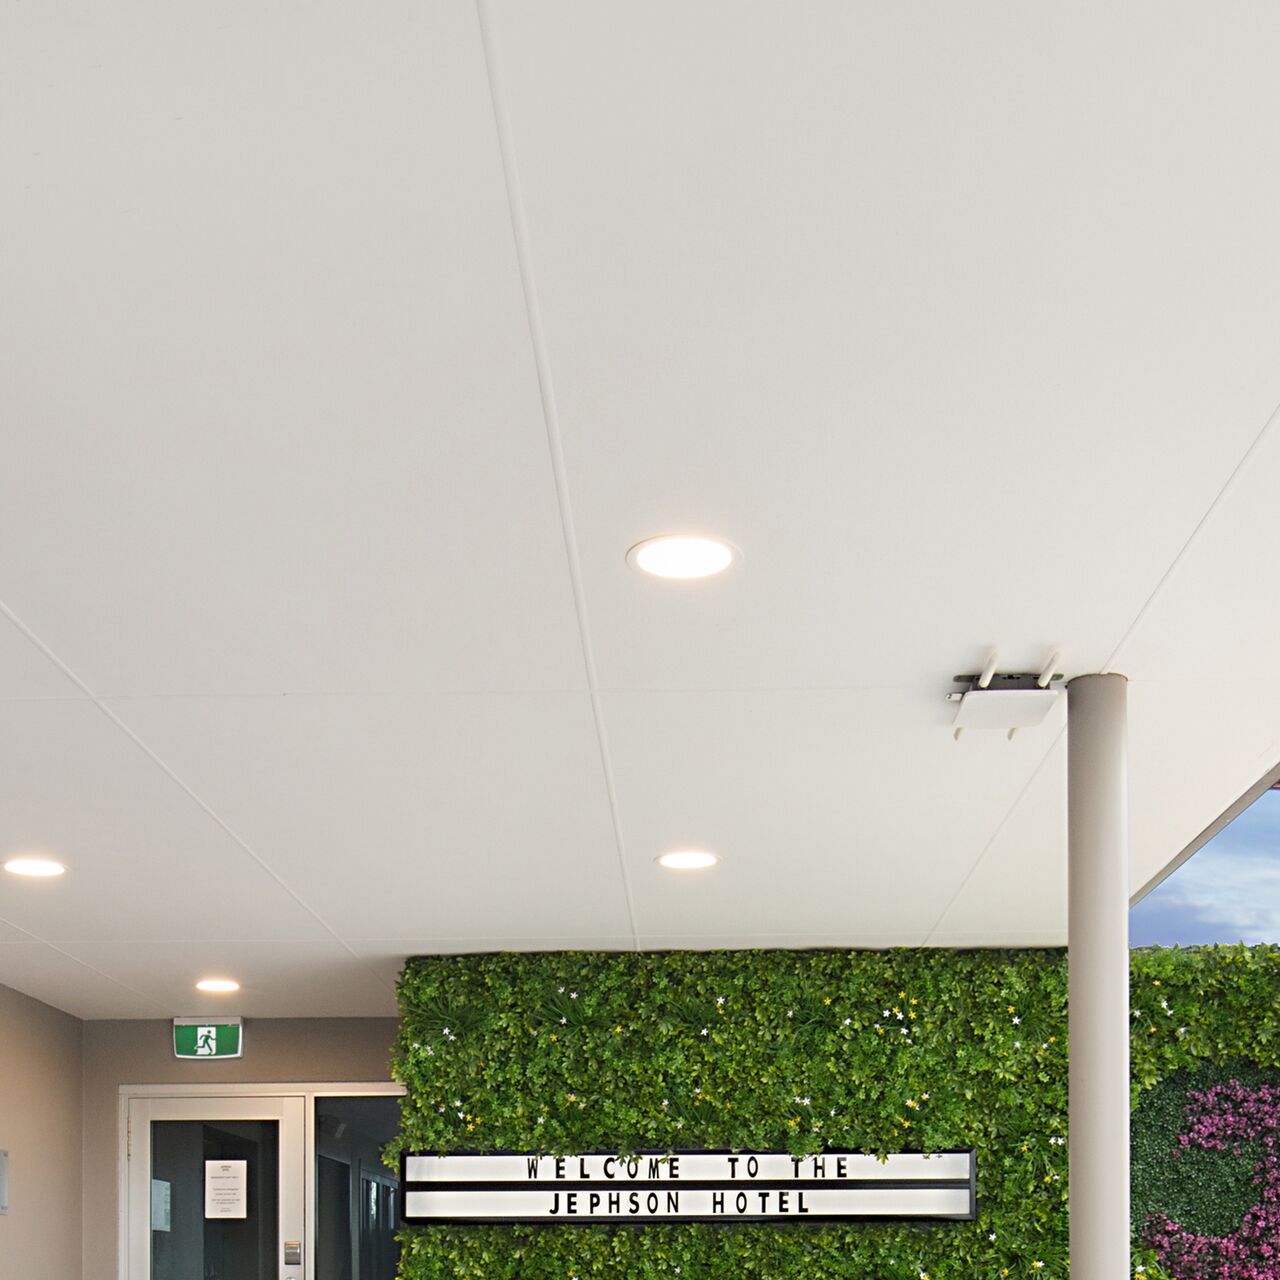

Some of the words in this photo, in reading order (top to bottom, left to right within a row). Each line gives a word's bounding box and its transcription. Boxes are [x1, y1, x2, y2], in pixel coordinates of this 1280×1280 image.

[527, 1157, 680, 1179] WELCOME
[727, 1156, 759, 1179] TO
[790, 1156, 847, 1179] THE
[549, 1191, 679, 1214] JEPHSON
[712, 1191, 809, 1214] HOTEL
